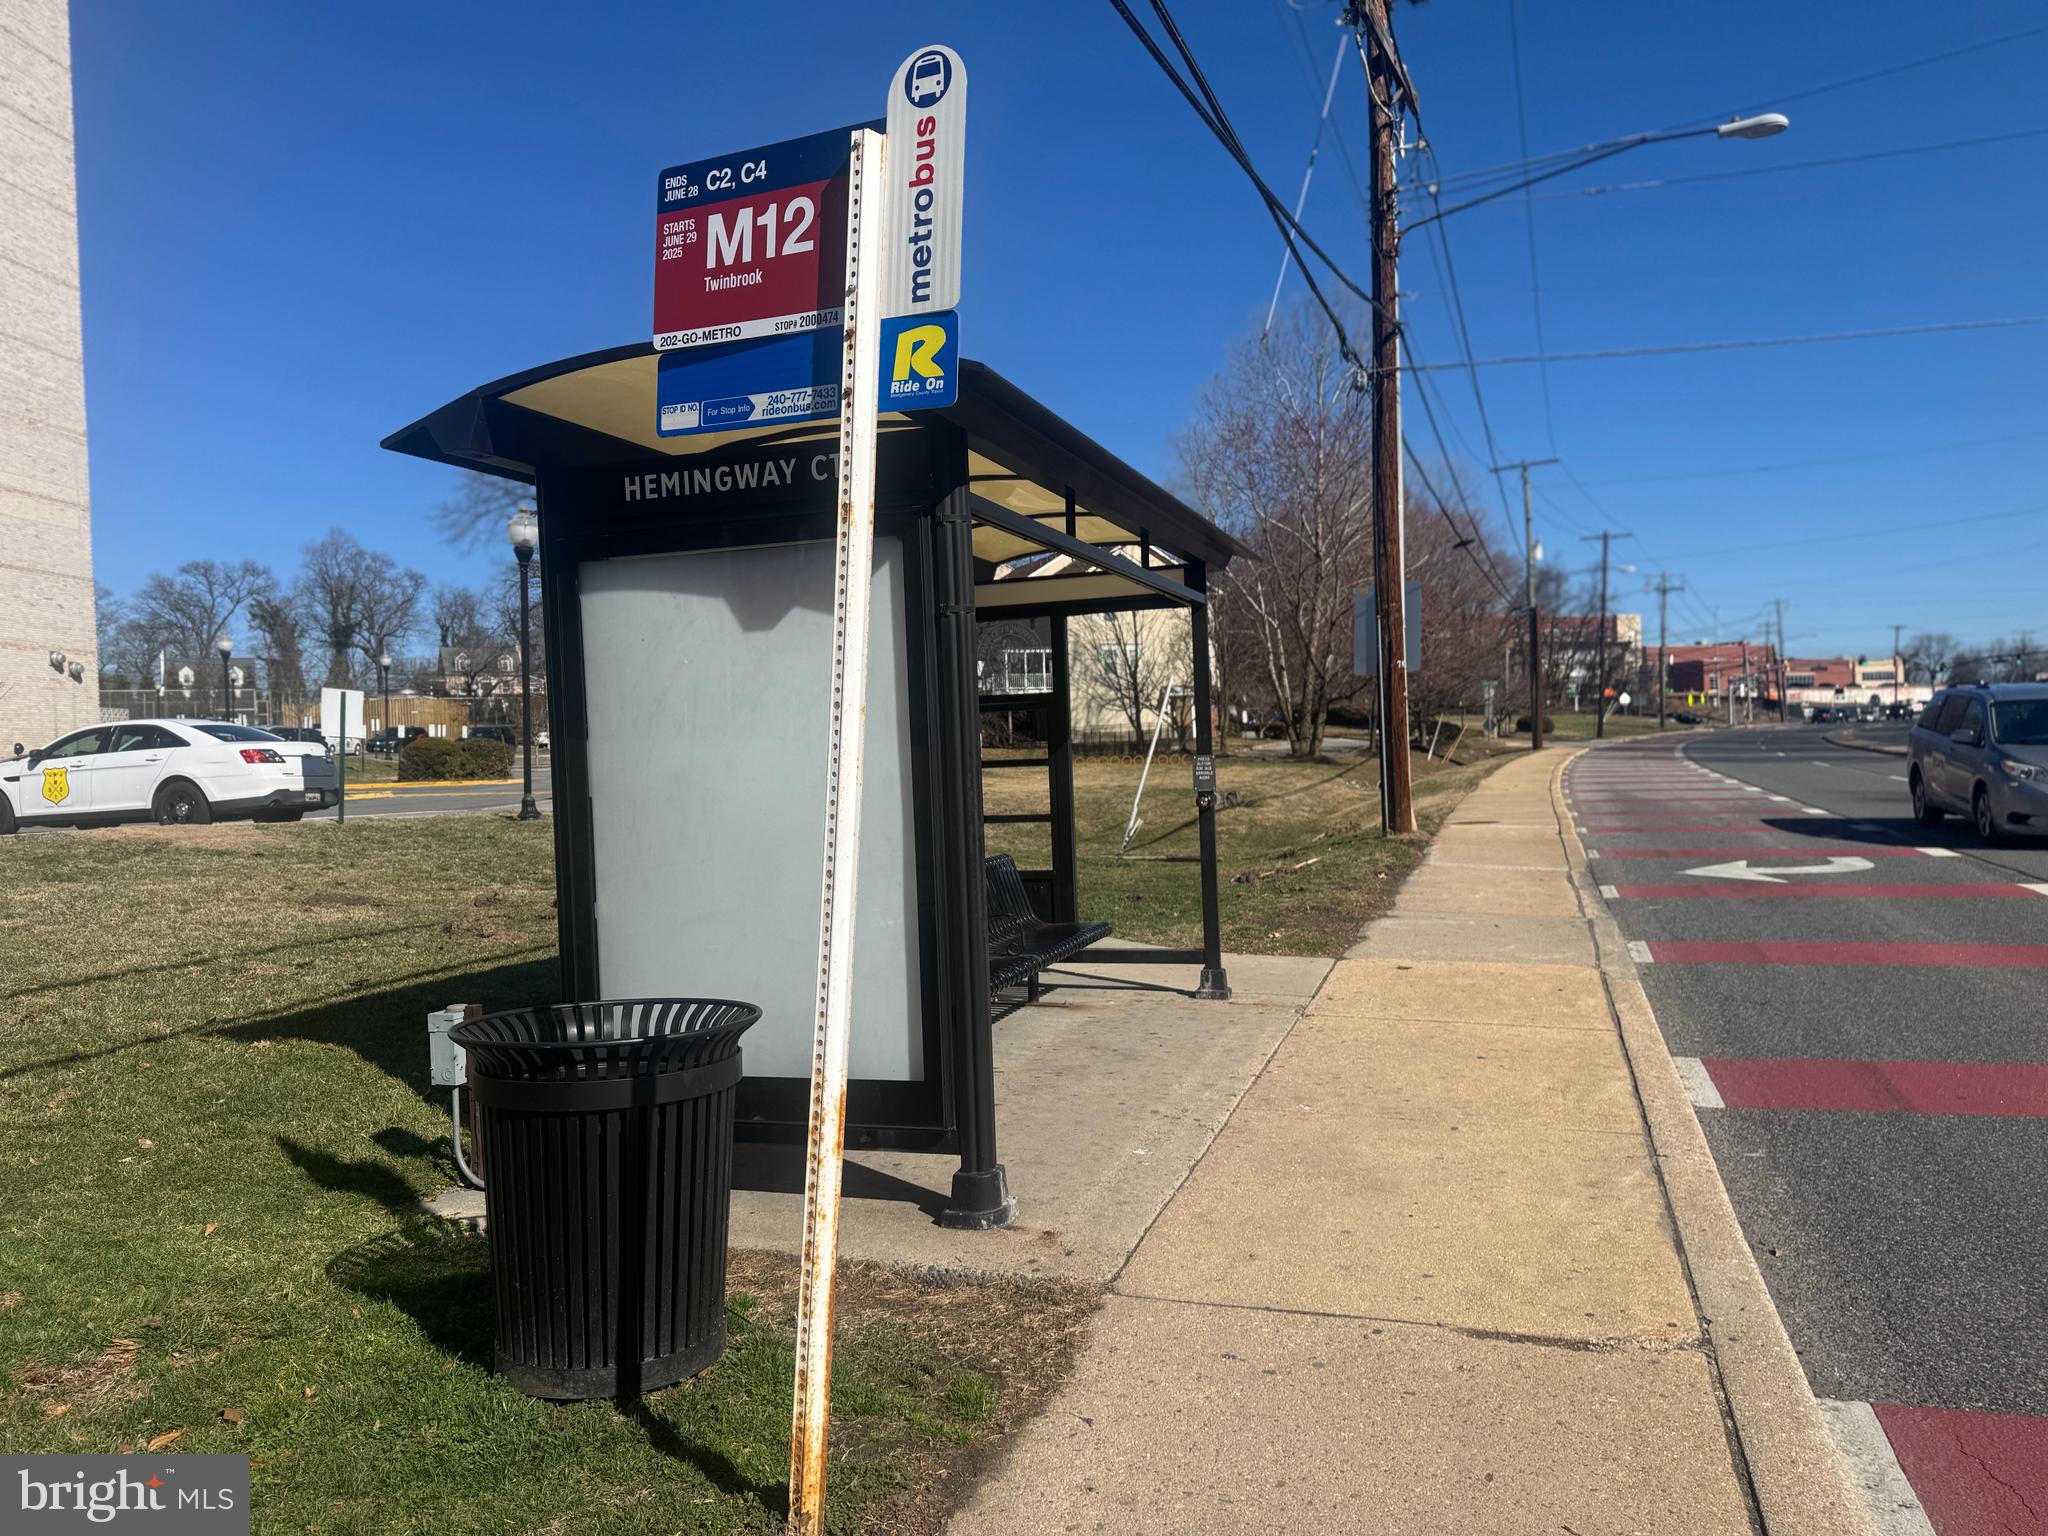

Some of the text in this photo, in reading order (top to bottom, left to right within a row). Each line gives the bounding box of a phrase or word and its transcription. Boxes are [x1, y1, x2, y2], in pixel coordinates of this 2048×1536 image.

[665, 175, 688, 189] ENDS
[706, 160, 767, 191] C2, C4
[664, 185, 699, 202] JUNE 28
[908, 115, 937, 303] metrobus
[663, 219, 696, 235] STARTS
[706, 196, 815, 269] M12
[662, 231, 697, 248] JUNE 29
[662, 247, 683, 261] 2025
[704, 268, 763, 292] Twinbrook
[775, 311, 839, 332] STOP# 2000474
[660, 326, 742, 347] 202-GO-METRO
[891, 377, 944, 393] Ride On
[767, 387, 837, 406] 240-777-7433
[662, 407, 679, 415] STOP
[687, 403, 699, 412] NO.
[707, 404, 750, 416] For Stop Info
[761, 400, 837, 417] rideonbus.com
[624, 458, 796, 501] HEMINGWAY
